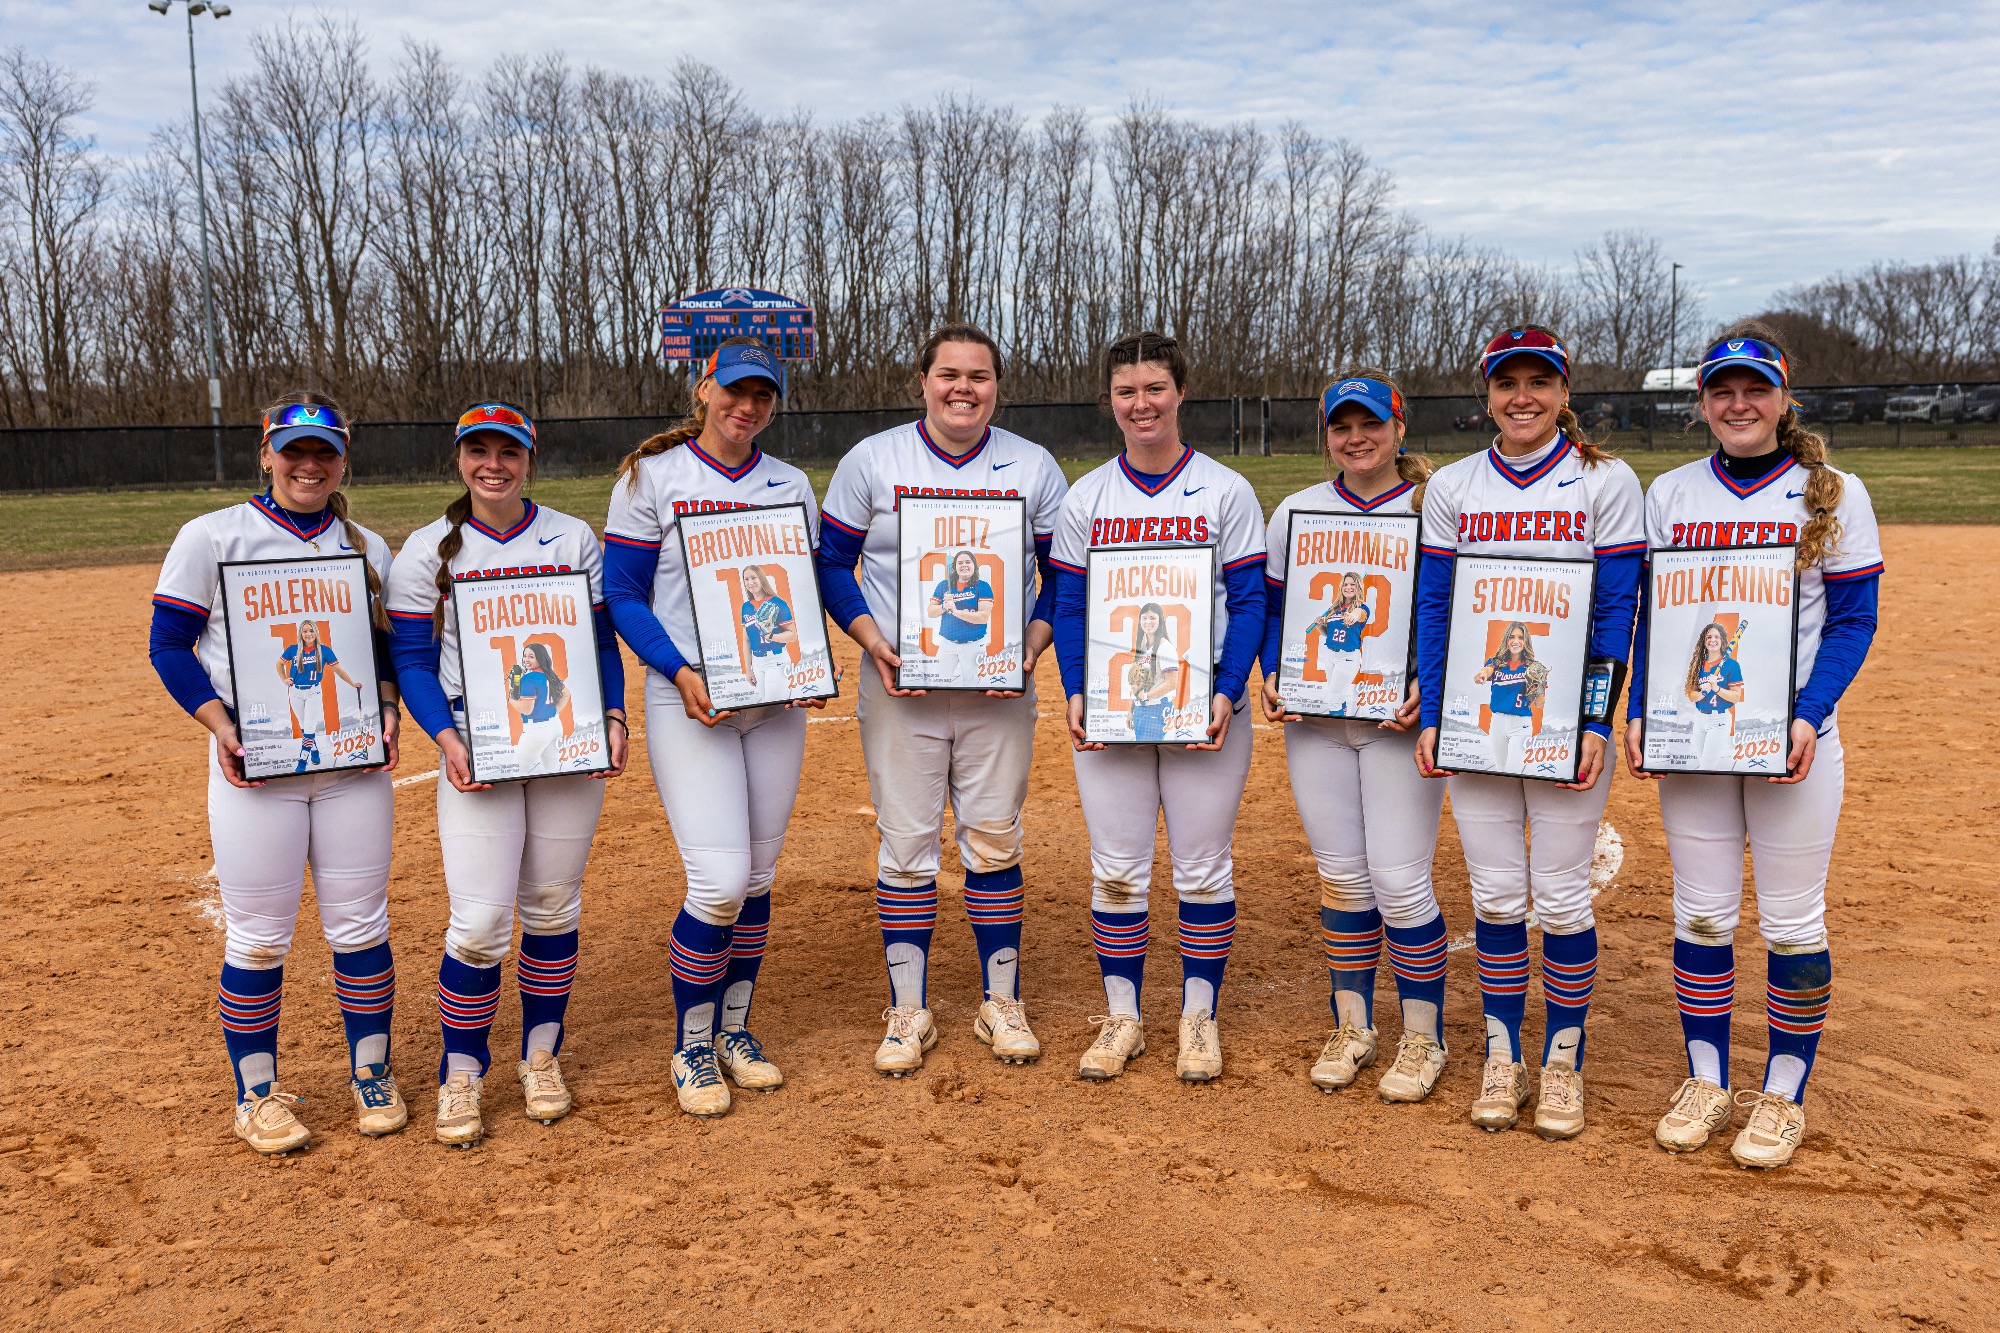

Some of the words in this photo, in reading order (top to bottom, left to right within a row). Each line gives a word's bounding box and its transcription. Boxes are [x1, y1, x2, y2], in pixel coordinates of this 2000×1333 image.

[679, 300, 723, 309] PIONEER
[752, 300, 797, 309] SOFTBALL
[665, 315, 684, 324] BALL
[705, 314, 731, 324] STRIKE
[752, 314, 767, 323] OUT
[664, 336, 692, 346] GUEST
[665, 348, 692, 358] HOME
[934, 515, 991, 550] DIETZ
[1090, 514, 1210, 547] PIONEERS
[1457, 510, 1587, 543] PIONEERS
[688, 523, 808, 568] BROWNLEE
[1296, 530, 1409, 572] BRUMMER
[1103, 564, 1197, 603] JACKSON
[1656, 565, 1791, 610] VOLKENING
[243, 578, 352, 622] SALERNO
[1472, 576, 1571, 619] STORMS
[472, 592, 577, 634] GIACOMO
[1332, 628, 1347, 643] 22
[976, 651, 1005, 666] Class
[1288, 643, 1308, 658] #22
[783, 662, 811, 677] Class
[787, 667, 826, 690] 2026
[977, 659, 1017, 679] 2026
[1356, 679, 1385, 694] Class
[1356, 689, 1399, 707] 2026
[1709, 694, 1718, 708] 4
[1163, 711, 1204, 732] 2026
[330, 727, 360, 744] Class
[333, 733, 376, 758] 2026
[555, 733, 586, 750] Class
[1523, 735, 1556, 750] Class
[1732, 729, 1765, 746] Class
[559, 740, 600, 763] 2026
[1523, 744, 1569, 764] 2026
[1733, 739, 1781, 761] 2026
